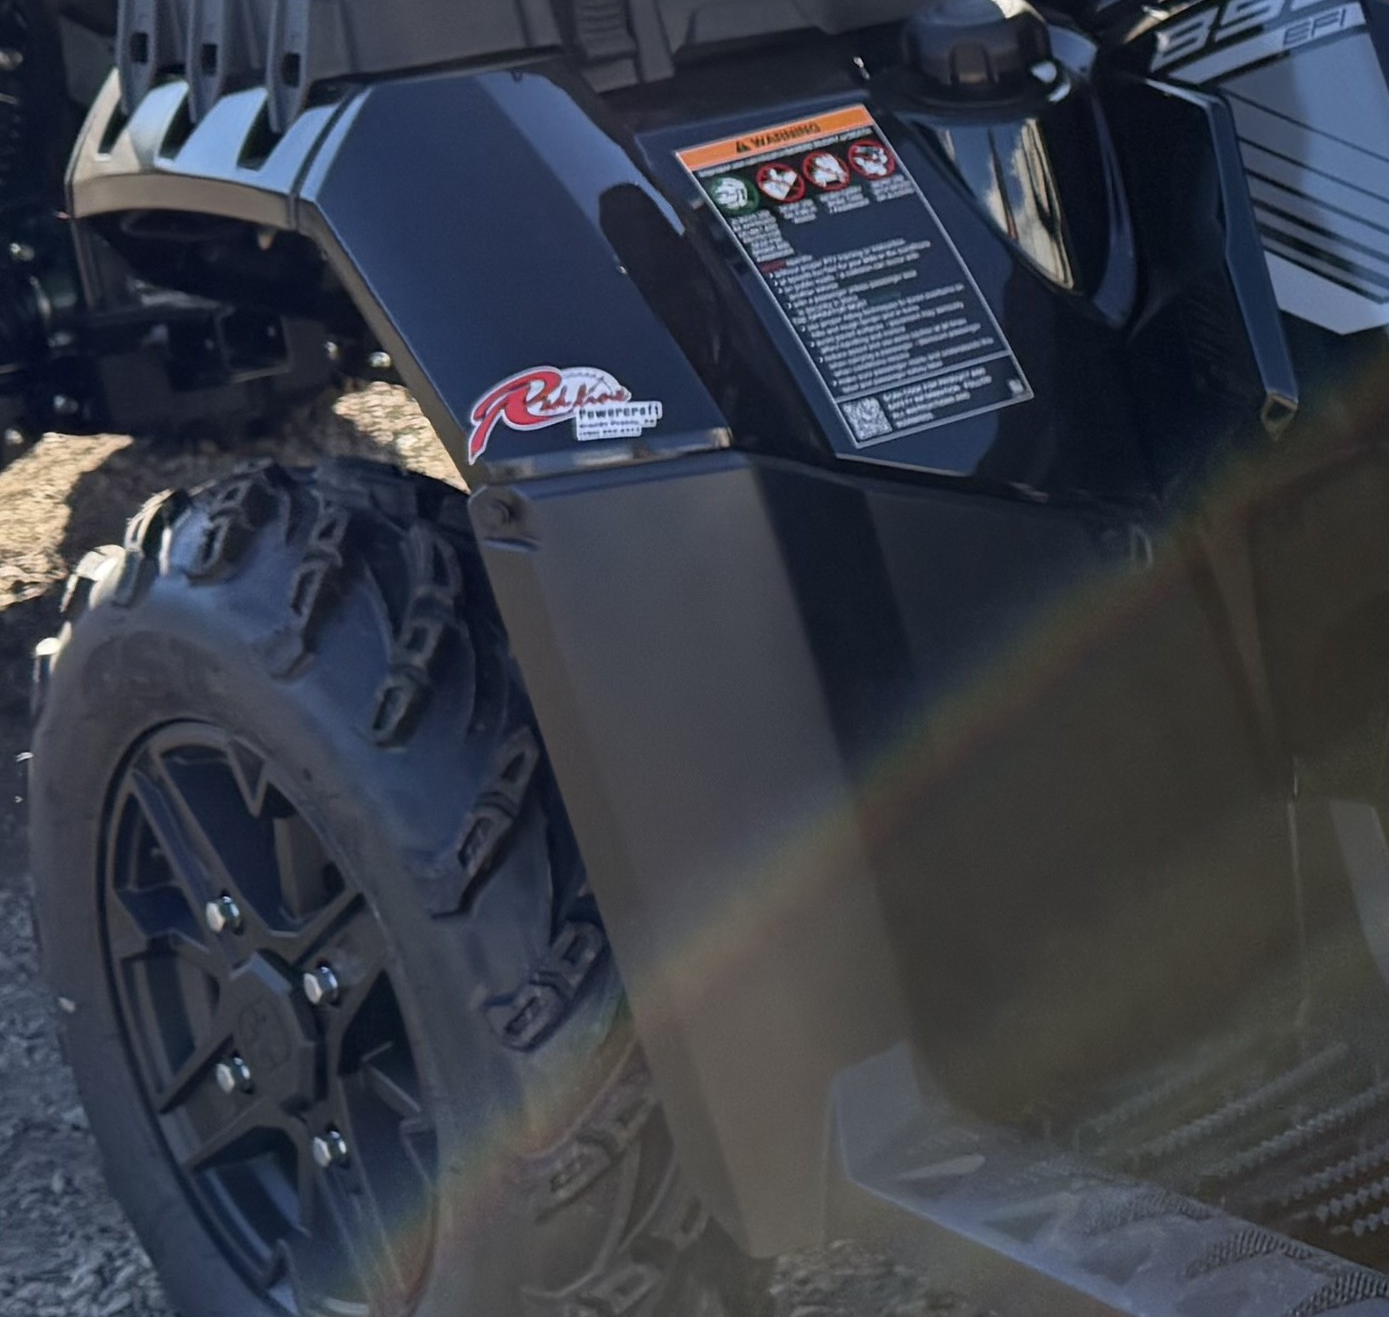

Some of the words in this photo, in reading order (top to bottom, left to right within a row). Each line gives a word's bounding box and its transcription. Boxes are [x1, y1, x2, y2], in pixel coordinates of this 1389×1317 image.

[1283, 9, 1345, 46] EFI
[752, 121, 821, 147] WARNING
[579, 403, 659, 420] Powercraft
